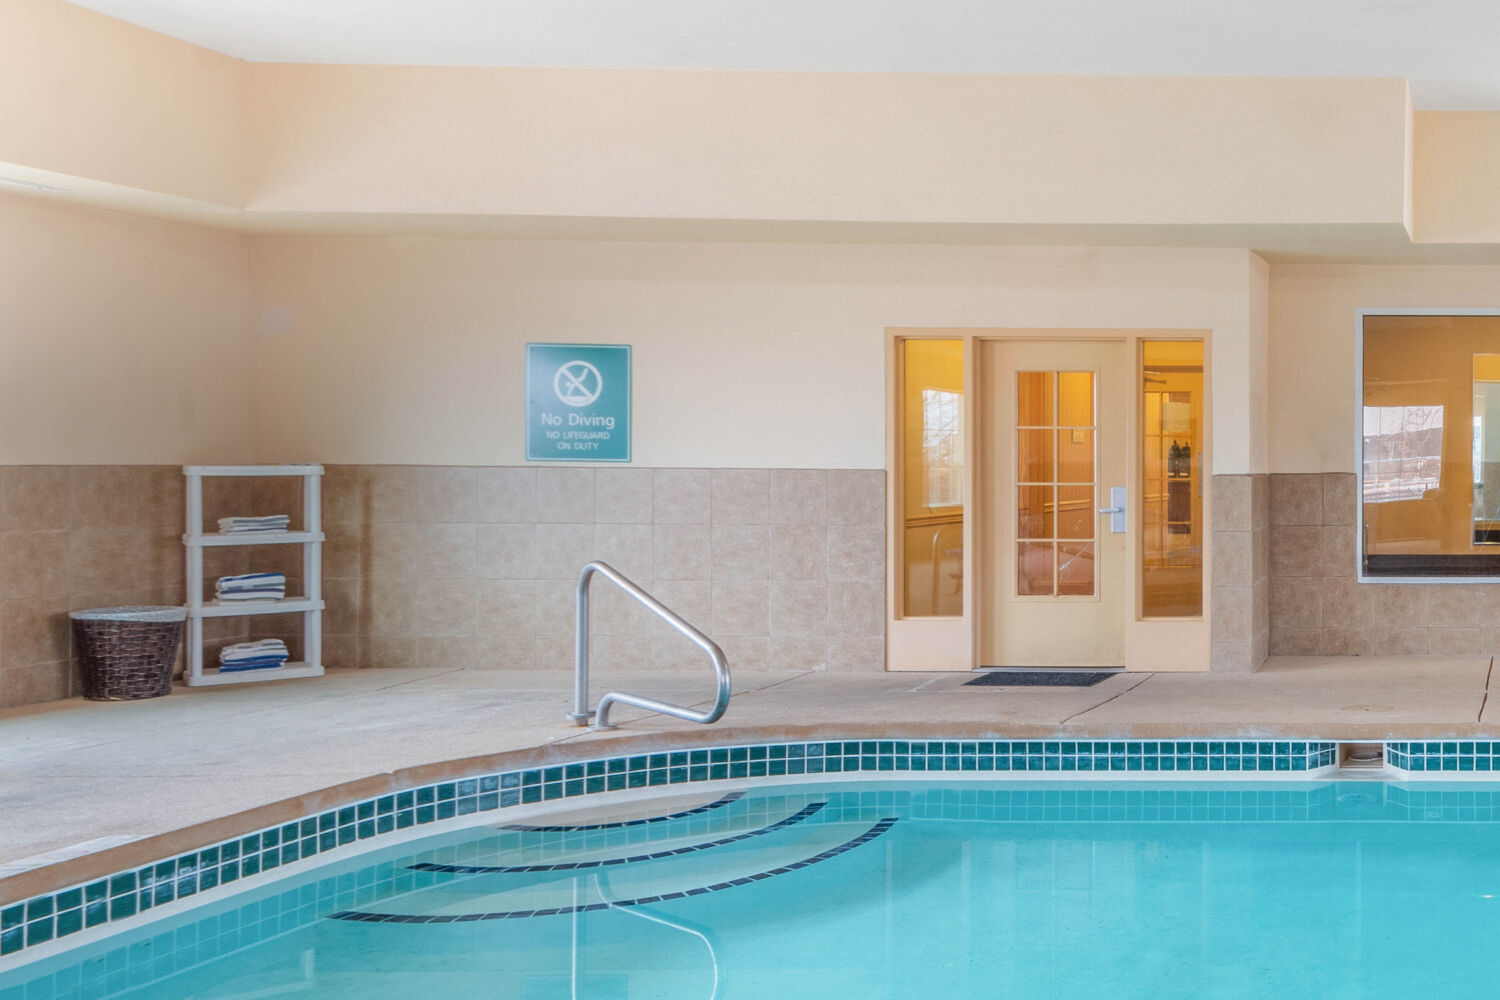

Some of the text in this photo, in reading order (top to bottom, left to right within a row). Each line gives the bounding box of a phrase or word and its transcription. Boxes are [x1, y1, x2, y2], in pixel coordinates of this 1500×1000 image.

[541, 413, 615, 430] No Diving
[546, 431, 610, 440] NO LIFEGUARD
[557, 442, 600, 450] ON DUTY
